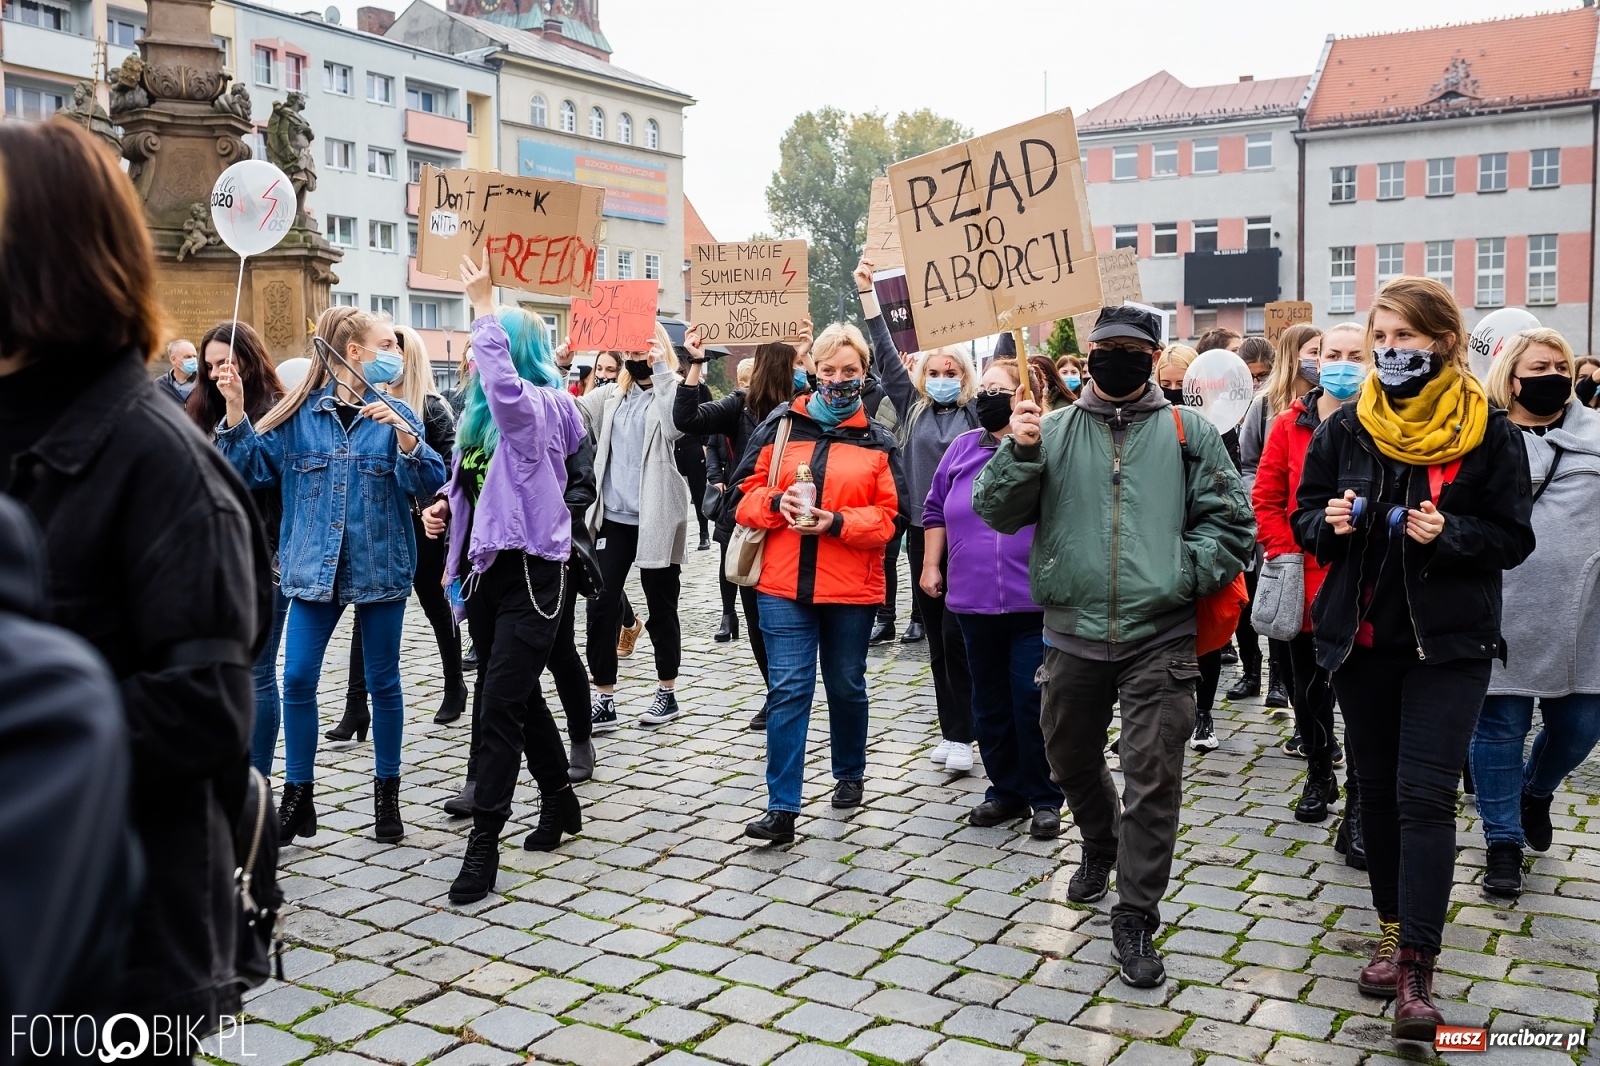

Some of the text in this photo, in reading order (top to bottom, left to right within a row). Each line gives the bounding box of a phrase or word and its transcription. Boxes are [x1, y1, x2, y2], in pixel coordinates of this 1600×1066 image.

[615, 164, 656, 178] MEDYCZNE
[435, 173, 475, 211] Don't
[907, 138, 1058, 232] RZĄD
[963, 216, 1005, 252] DO
[698, 244, 782, 262] NIE MACIE
[700, 267, 772, 286] SUMIENIA
[923, 228, 1076, 308] ABORCJI
[701, 289, 788, 307] ZMUSZAJĄC
[729, 307, 758, 322] NAS
[1270, 307, 1311, 322] TO JEST
[696, 321, 798, 340] DO RODZENIA
